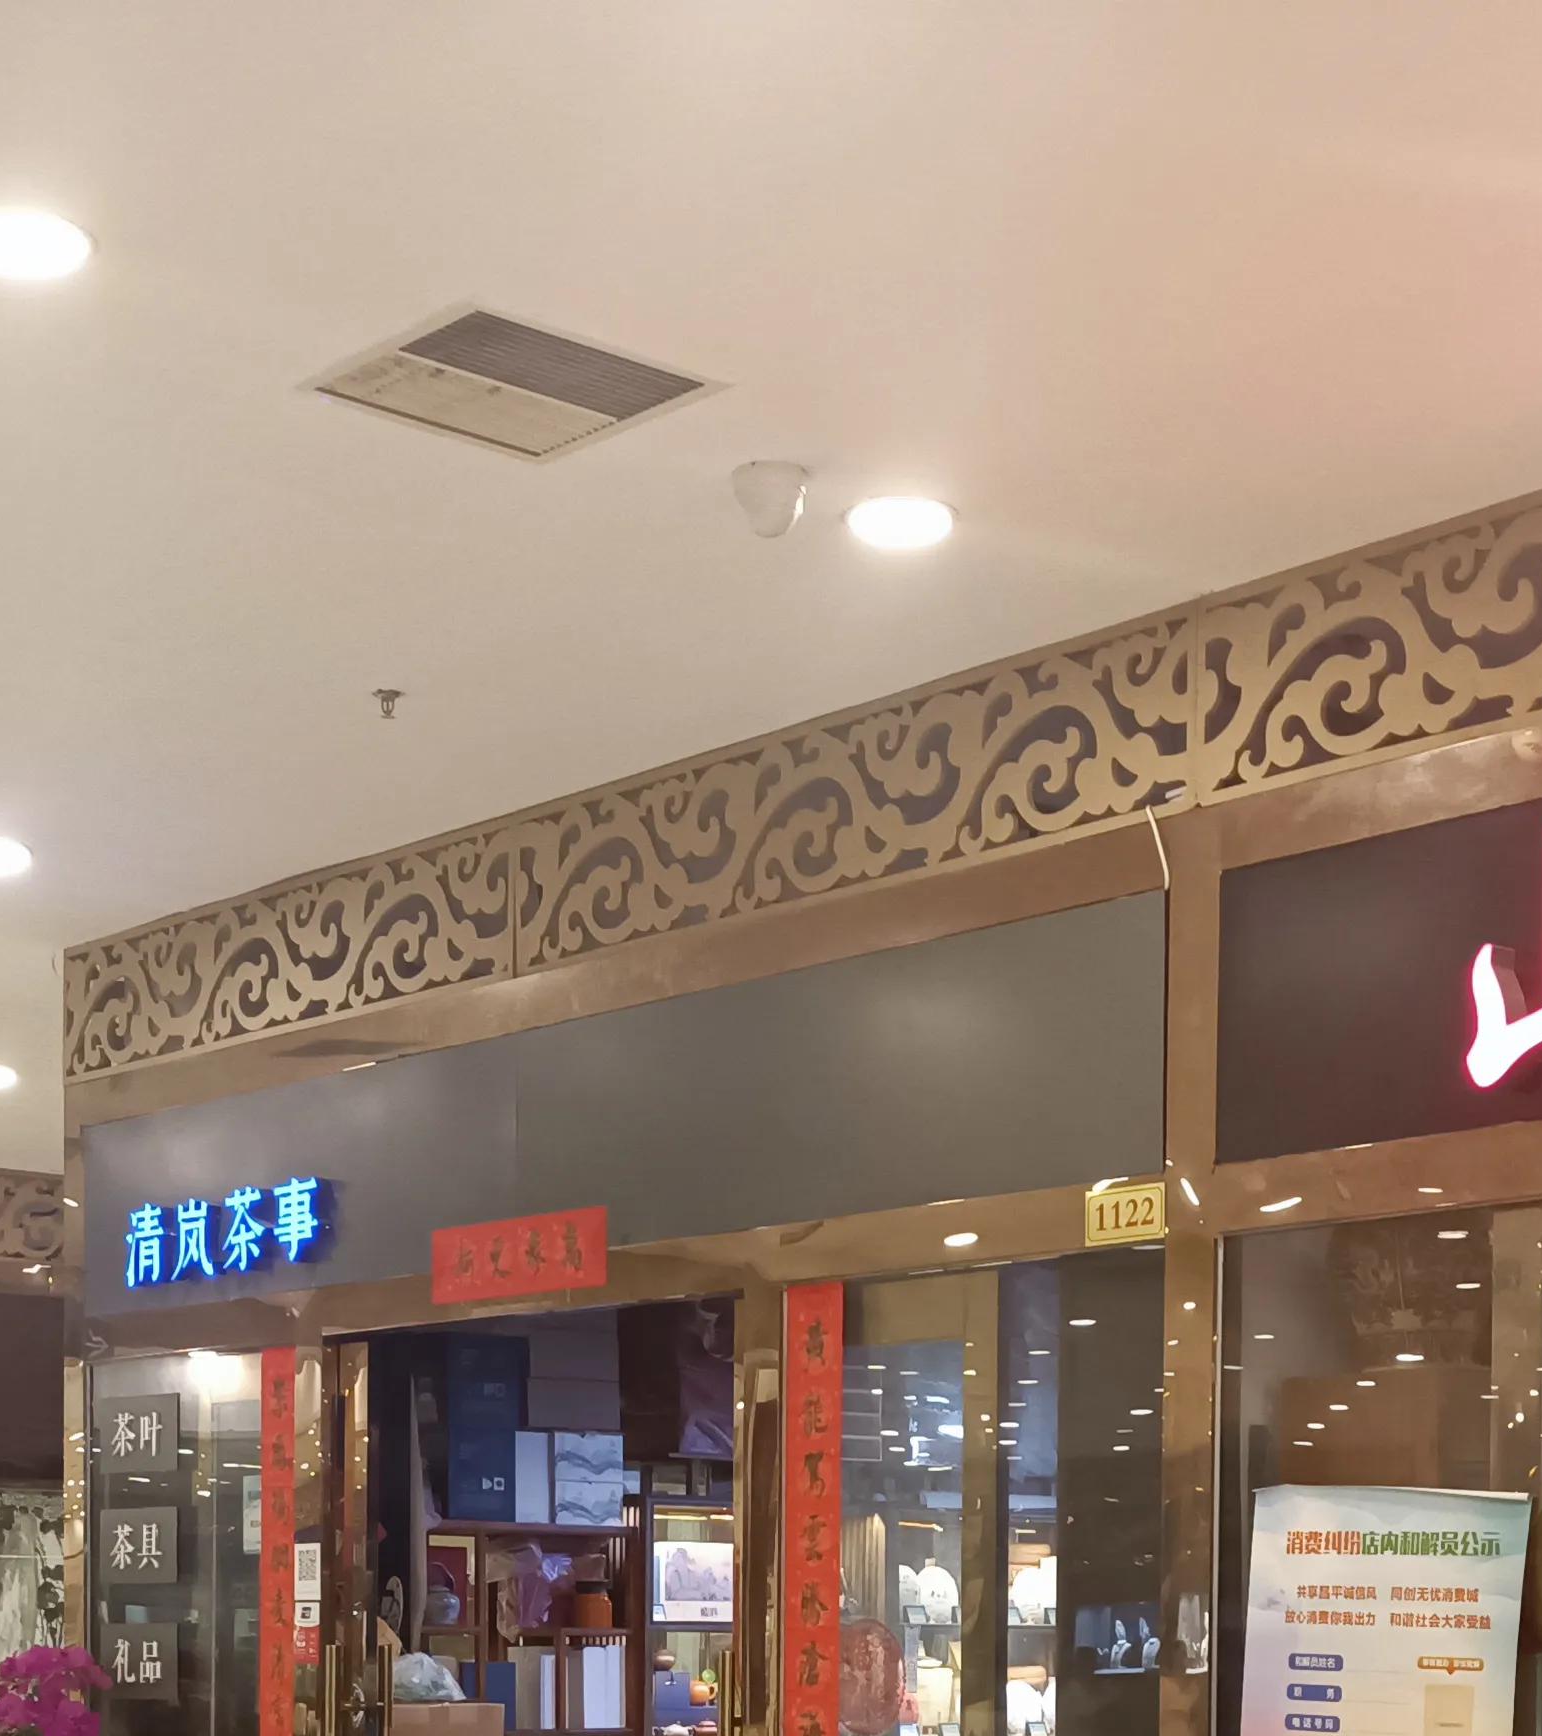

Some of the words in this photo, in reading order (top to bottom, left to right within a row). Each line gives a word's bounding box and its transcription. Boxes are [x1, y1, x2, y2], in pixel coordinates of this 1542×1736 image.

[125, 1176, 318, 1288] 清岚茶事
[1095, 1197, 1155, 1232] 1122
[111, 1411, 163, 1457] 茶叶
[109, 1523, 163, 1570] 茶具
[1286, 1530, 1501, 1557] 消费纠纷店内和解员公示
[111, 1638, 163, 1685] 礼品
